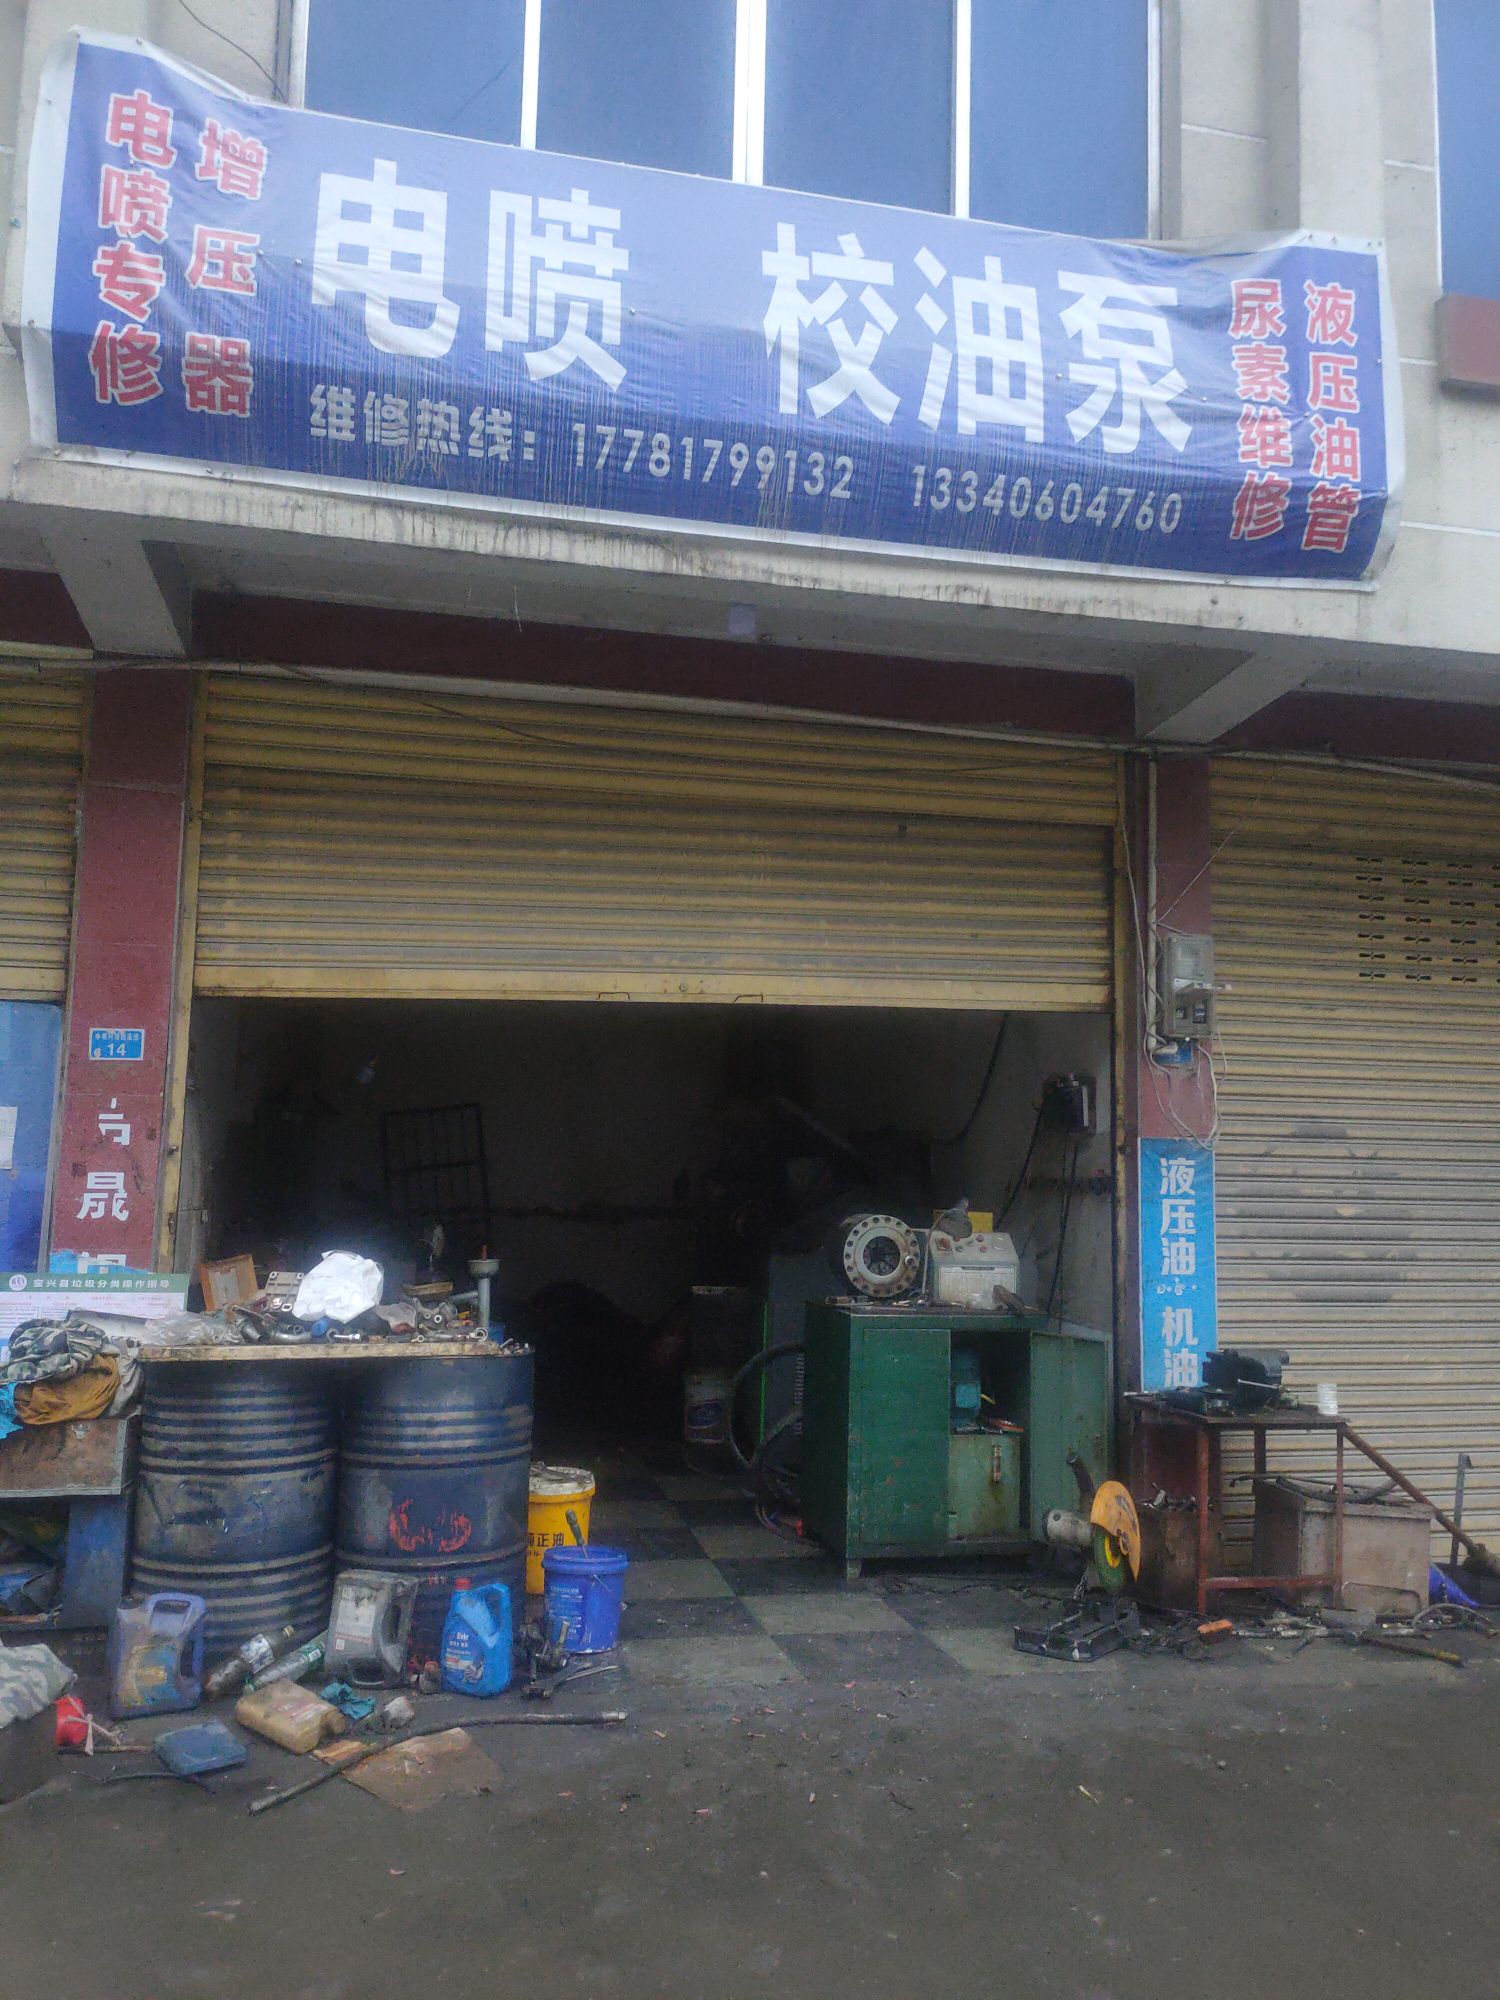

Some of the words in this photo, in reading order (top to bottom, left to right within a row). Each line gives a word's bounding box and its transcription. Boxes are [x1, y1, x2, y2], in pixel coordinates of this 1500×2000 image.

[90, 89, 177, 407] 电喷专修
[182, 117, 268, 418] 增压器
[310, 157, 630, 392] 电喷
[762, 222, 1192, 454] 校油泵
[310, 384, 536, 462] 维修热线：
[572, 423, 854, 500] 17781799132
[911, 464, 1182, 534] 13340604760
[1228, 278, 1293, 541] 尿素维修
[1300, 279, 1362, 554] 液压油管
[1159, 1157, 1197, 1276] 液压油
[1161, 1305, 1199, 1388] 机油
